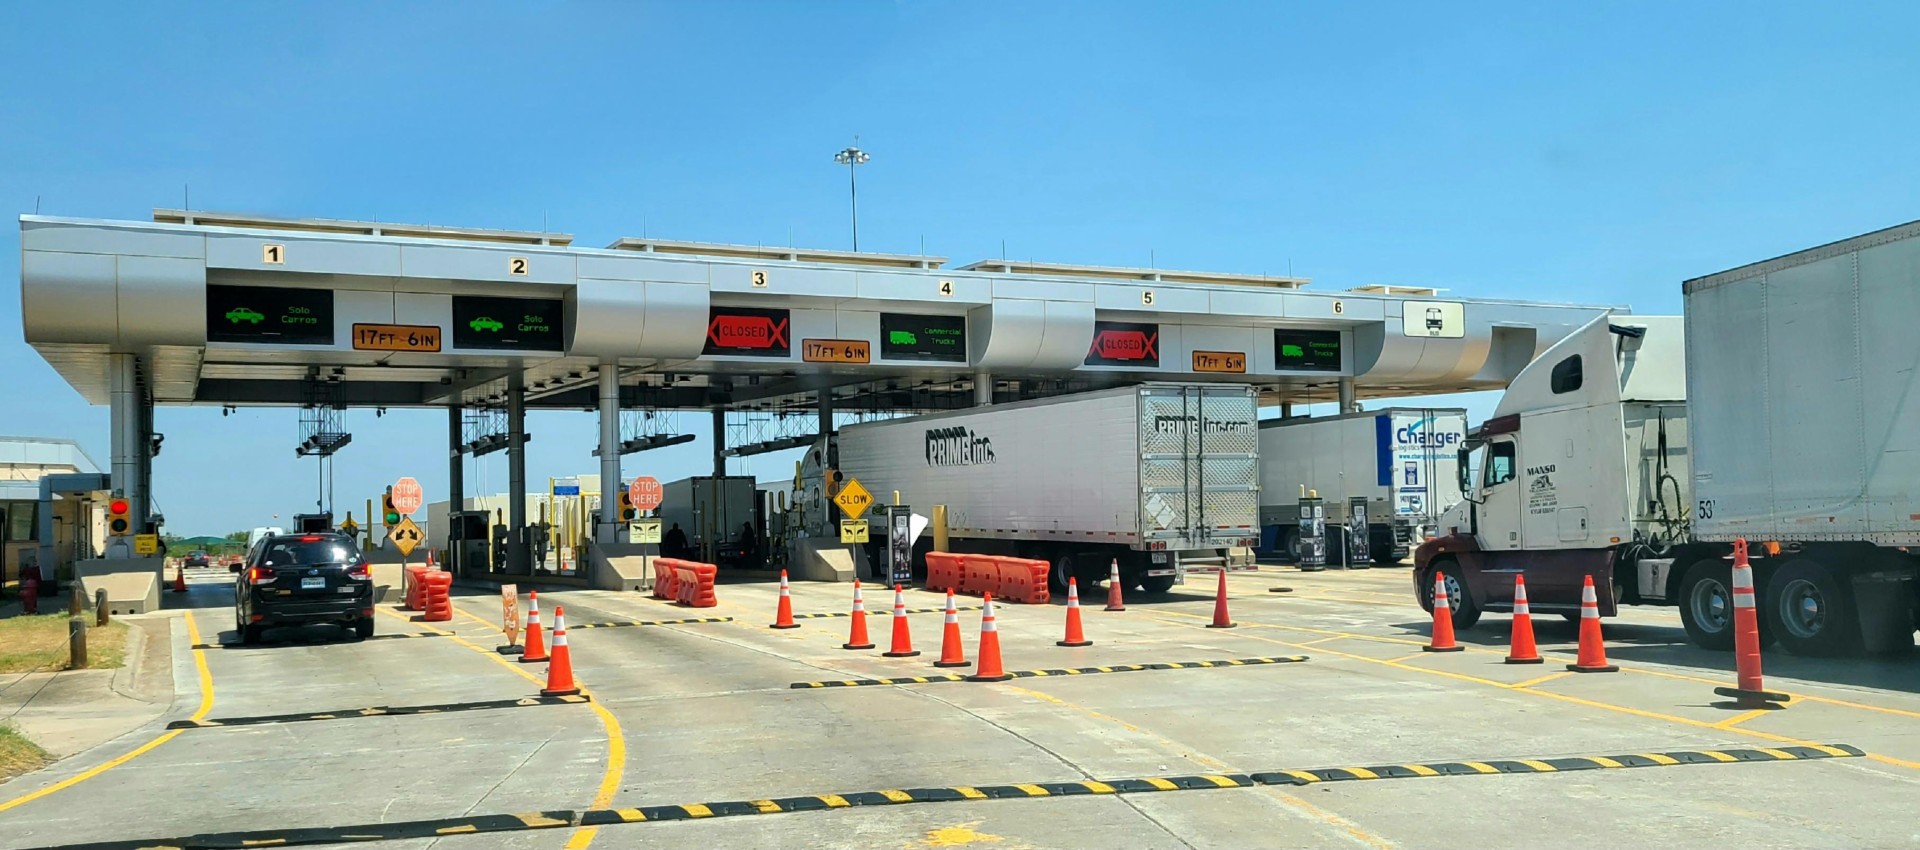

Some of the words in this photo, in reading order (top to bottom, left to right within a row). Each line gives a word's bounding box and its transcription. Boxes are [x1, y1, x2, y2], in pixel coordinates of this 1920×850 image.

[268, 246, 279, 262] 1
[513, 259, 525, 274] 2
[754, 272, 765, 285] 3
[941, 282, 952, 296] 4
[1143, 291, 1153, 304] 5
[288, 306, 310, 314] Solo
[1334, 302, 1343, 314] 6
[281, 315, 317, 324] Carros
[524, 314, 543, 323] Solo
[518, 323, 549, 332] Carros
[722, 325, 765, 338] CLOSED
[924, 327, 962, 336] Commercial
[360, 329, 396, 345] 17FT
[408, 331, 434, 346] 6IN
[1105, 339, 1140, 350] CLOSED
[808, 344, 835, 357] 17FT
[845, 346, 865, 359] 6IN
[1197, 355, 1218, 369] 17FT
[1226, 357, 1242, 369] 6IN
[1155, 416, 1199, 435] PRIME
[1397, 424, 1461, 448] Charger
[926, 427, 969, 467] PRIME
[1527, 464, 1556, 476] MANSO
[397, 484, 418, 494] STOP
[634, 481, 658, 492] STOP
[397, 497, 418, 507] HERE
[633, 494, 658, 505] HERE
[840, 495, 867, 505] SLOW
